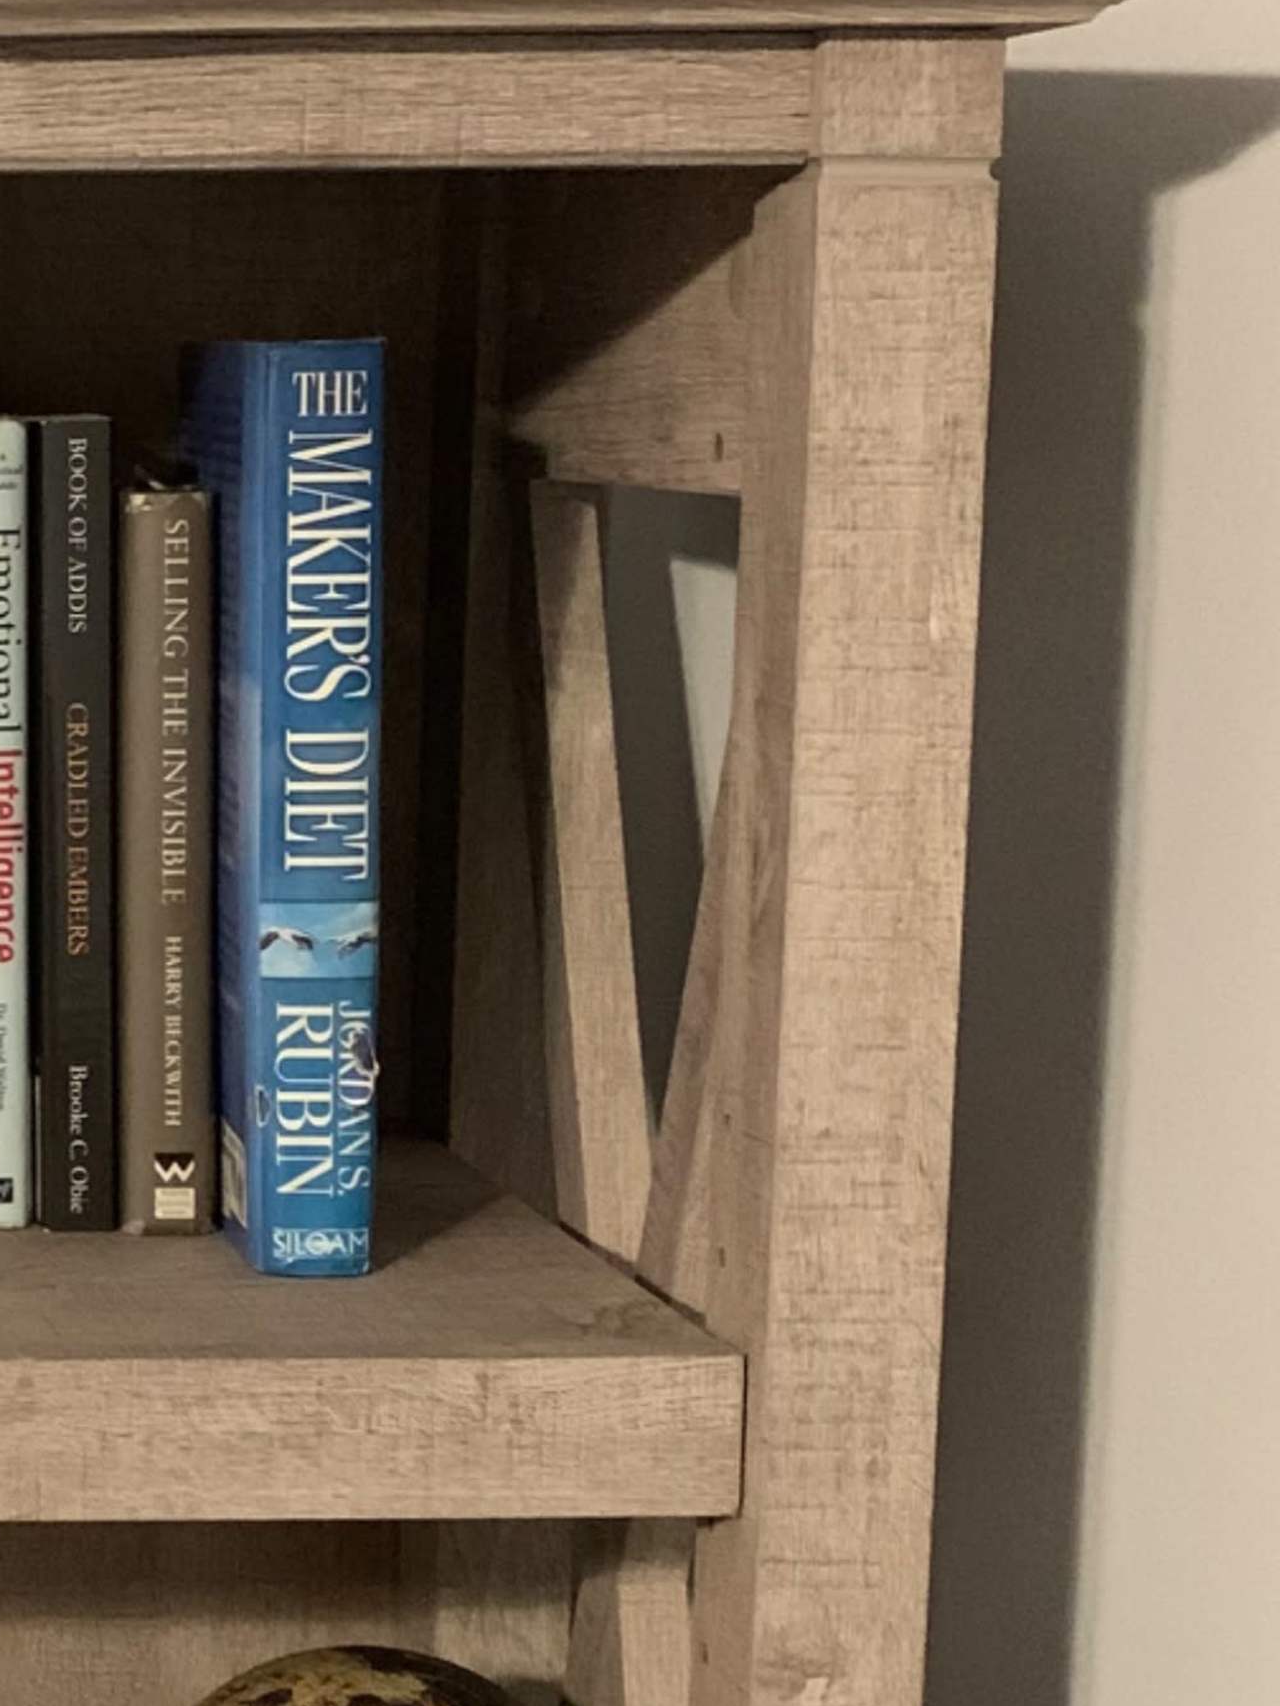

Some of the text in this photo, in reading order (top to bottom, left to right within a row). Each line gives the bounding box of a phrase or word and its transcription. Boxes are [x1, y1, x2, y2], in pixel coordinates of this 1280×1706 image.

[291, 368, 369, 418] THE
[66, 436, 90, 956] BOOK OF ADDIS CRADLED EMBERS
[161, 518, 190, 906] SELLING THE INVISIBLE
[283, 427, 375, 881] MAKER'S DIET
[163, 935, 184, 1128] HARRY BECKWITH
[273, 1001, 335, 1199] RUBIN
[68, 1064, 90, 1215] Brooke Obie
